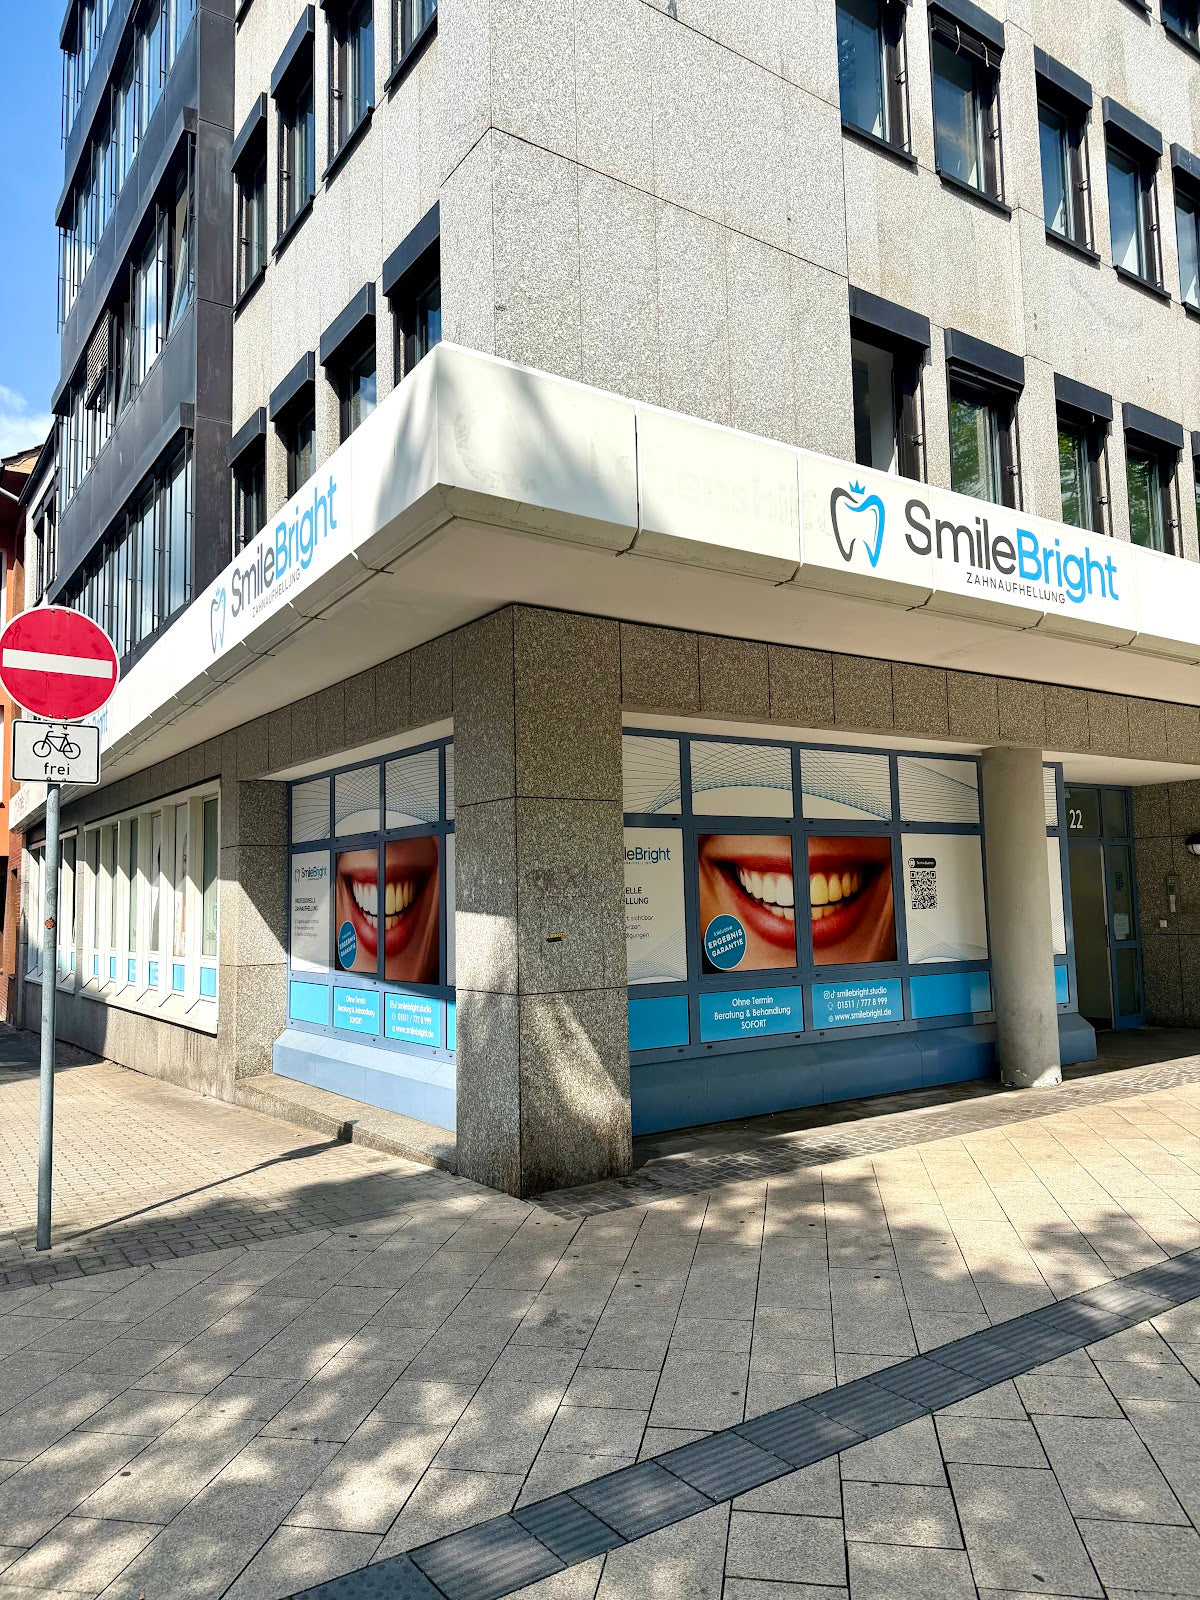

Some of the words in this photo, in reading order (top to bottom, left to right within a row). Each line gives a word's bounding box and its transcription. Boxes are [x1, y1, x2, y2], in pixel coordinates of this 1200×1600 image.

[231, 475, 337, 618] SmileBright
[904, 498, 1119, 604] SmileBright
[252, 568, 301, 618] ZAHNAUFHELLUNG
[966, 571, 1066, 604] ZAHNAUFHELLUNG
[44, 762, 70, 776] frei
[1069, 809, 1083, 829] 22
[708, 928, 743, 949] ERGEBNIS
[711, 938, 744, 957] GARANTIE
[836, 986, 888, 998] smilebright.studio
[731, 997, 751, 1007] Ohne
[751, 995, 774, 1005] Termin
[837, 1000, 856, 1010] 01511
[860, 999, 872, 1008] 777
[872, 998, 877, 1006] 8
[877, 997, 888, 1006] 999
[714, 1011, 745, 1021] Beratung
[746, 1009, 751, 1017] &
[752, 1006, 791, 1016] Behandlung
[834, 1008, 892, 1020] www.smilebright.de
[741, 1019, 767, 1030] SOFORT
